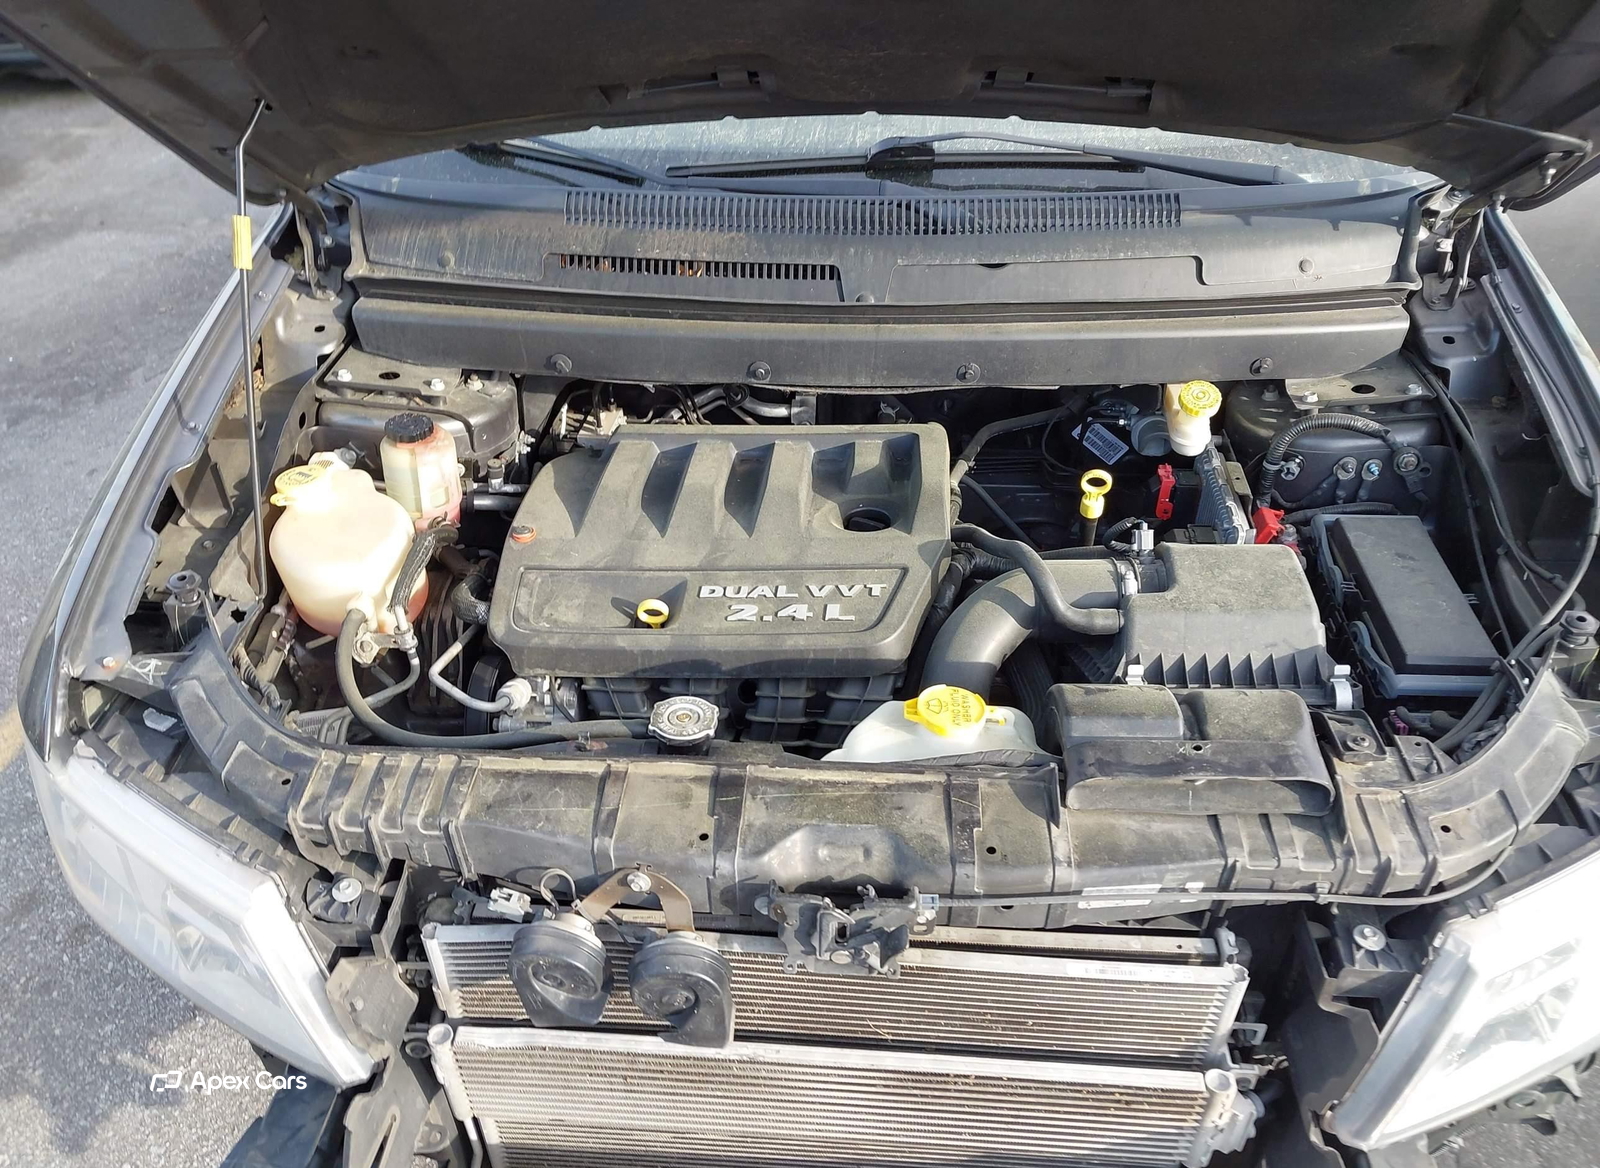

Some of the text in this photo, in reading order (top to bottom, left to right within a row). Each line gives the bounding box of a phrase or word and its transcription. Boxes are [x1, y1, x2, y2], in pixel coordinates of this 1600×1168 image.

[698, 583, 887, 599] DUAL VVT
[726, 603, 856, 622] 2.4 L
[950, 688, 962, 727] FLUID ONLY
[961, 694, 972, 723] WASHER
